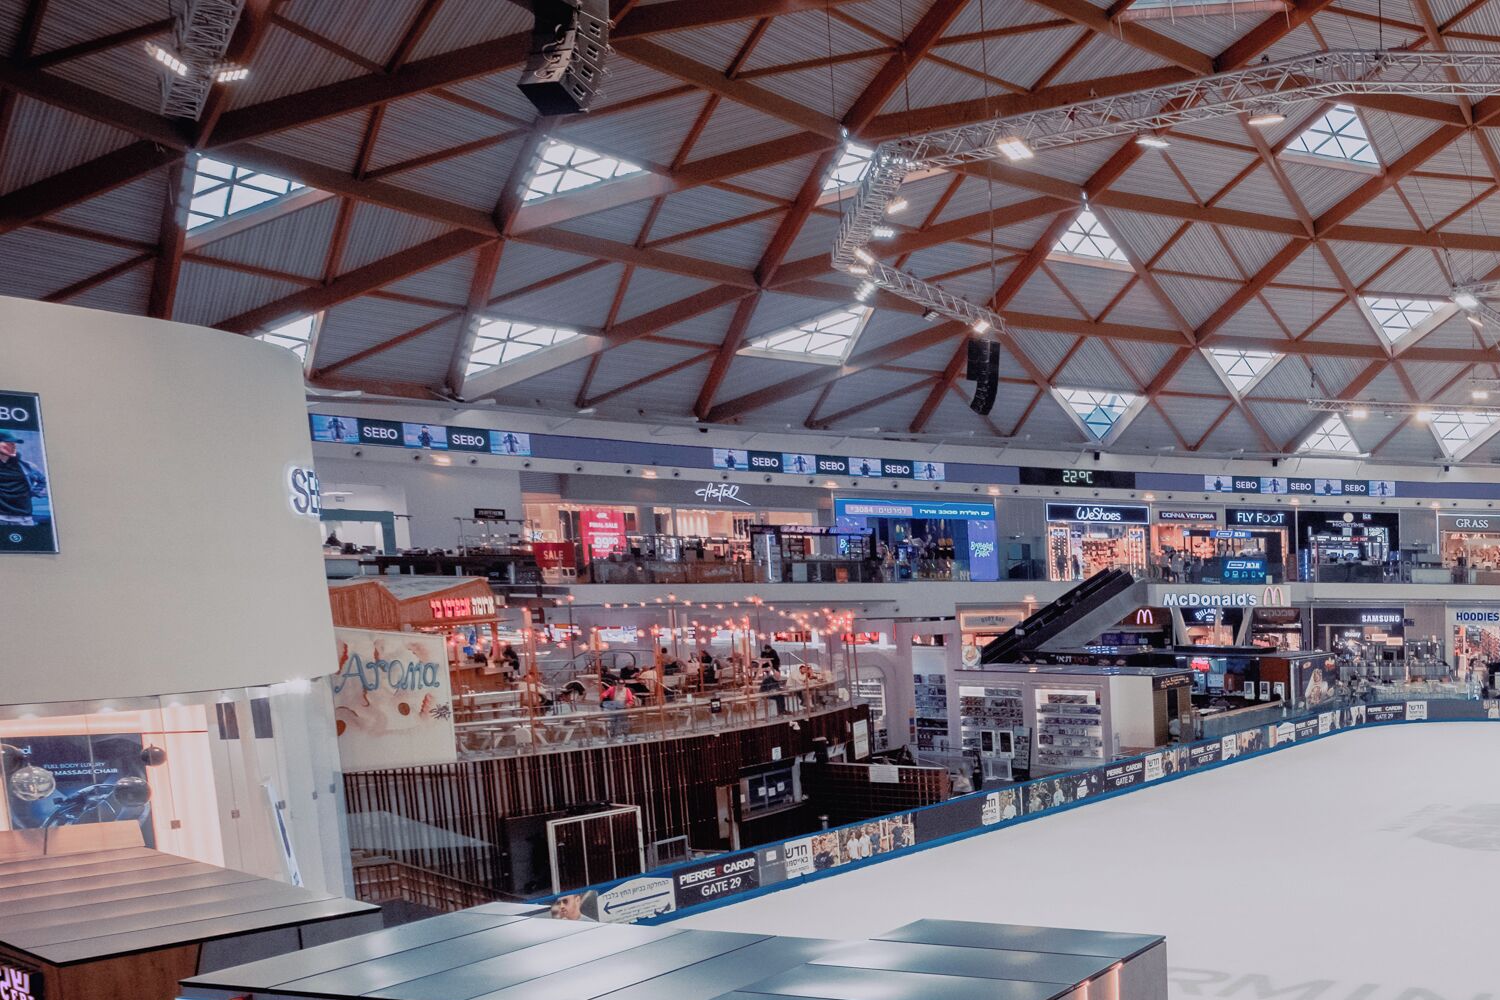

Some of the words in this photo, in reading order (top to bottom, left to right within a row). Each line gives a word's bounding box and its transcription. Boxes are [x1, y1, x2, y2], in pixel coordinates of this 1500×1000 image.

[363, 426, 398, 440] SEBO
[452, 434, 485, 447] SEBO
[752, 457, 779, 468] SEBO
[820, 461, 845, 472] SEBO
[885, 465, 910, 475] SEBO
[1236, 481, 1257, 489] SEBO
[1290, 482, 1311, 490] SEBO
[1344, 484, 1366, 492] SEBO
[1076, 506, 1121, 521] WeShoes
[1237, 512, 1254, 522] FLY
[1256, 512, 1285, 523] FOOT
[1456, 518, 1489, 528] GRASS
[543, 549, 564, 561] SALE
[1163, 594, 1258, 606] McDonald's
[1361, 615, 1401, 623] SAMSUNG
[334, 653, 441, 694] Aroma
[679, 867, 716, 886] PIERRE
[701, 880, 729, 897] GATE
[729, 876, 742, 888] 29
